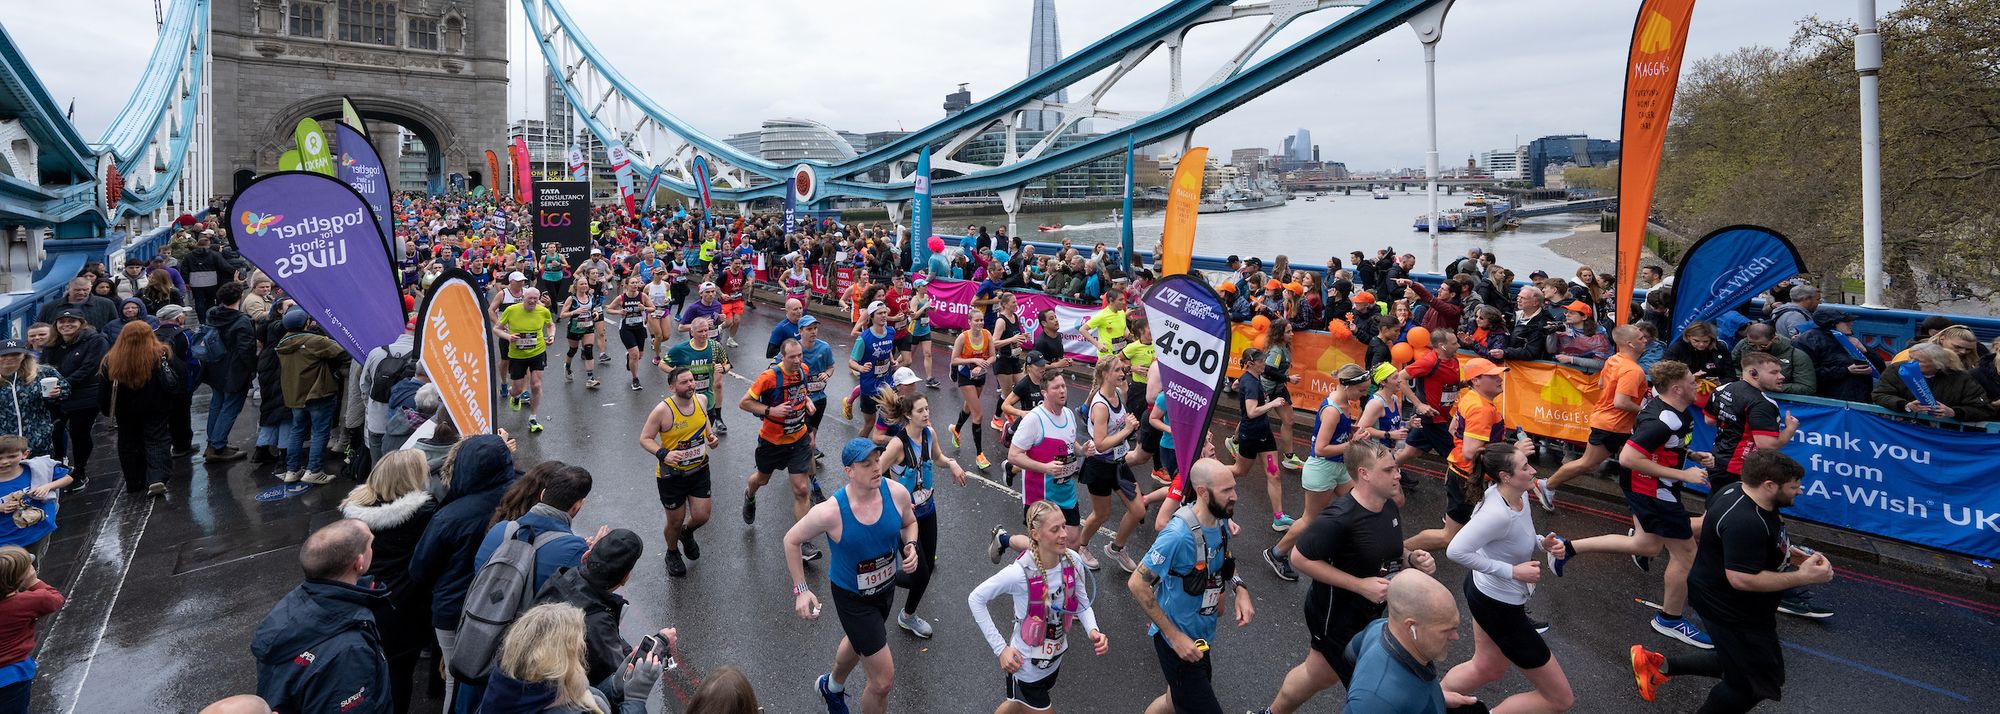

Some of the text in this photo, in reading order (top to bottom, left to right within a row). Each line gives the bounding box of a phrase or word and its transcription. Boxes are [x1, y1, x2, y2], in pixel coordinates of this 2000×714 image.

[304, 158, 328, 171] OXFAM
[914, 198, 921, 213] UK
[540, 209, 572, 227] tcs
[785, 208, 795, 233] rust
[912, 214, 921, 264] Dementia
[816, 269, 828, 290] tc
[1184, 306, 1206, 320] EVENTS
[1185, 301, 1220, 321] MARATHON
[1187, 296, 1212, 312] LONDON
[1164, 319, 1180, 331] SUB
[1155, 330, 1219, 375] 4:00
[1166, 389, 1203, 412] ACTIVITY
[1168, 380, 1208, 406] INSPIRING
[1789, 428, 1931, 465] hank you
[1810, 453, 1883, 483] from
[1943, 502, 2000, 534] UK
[865, 566, 893, 585] 19112
